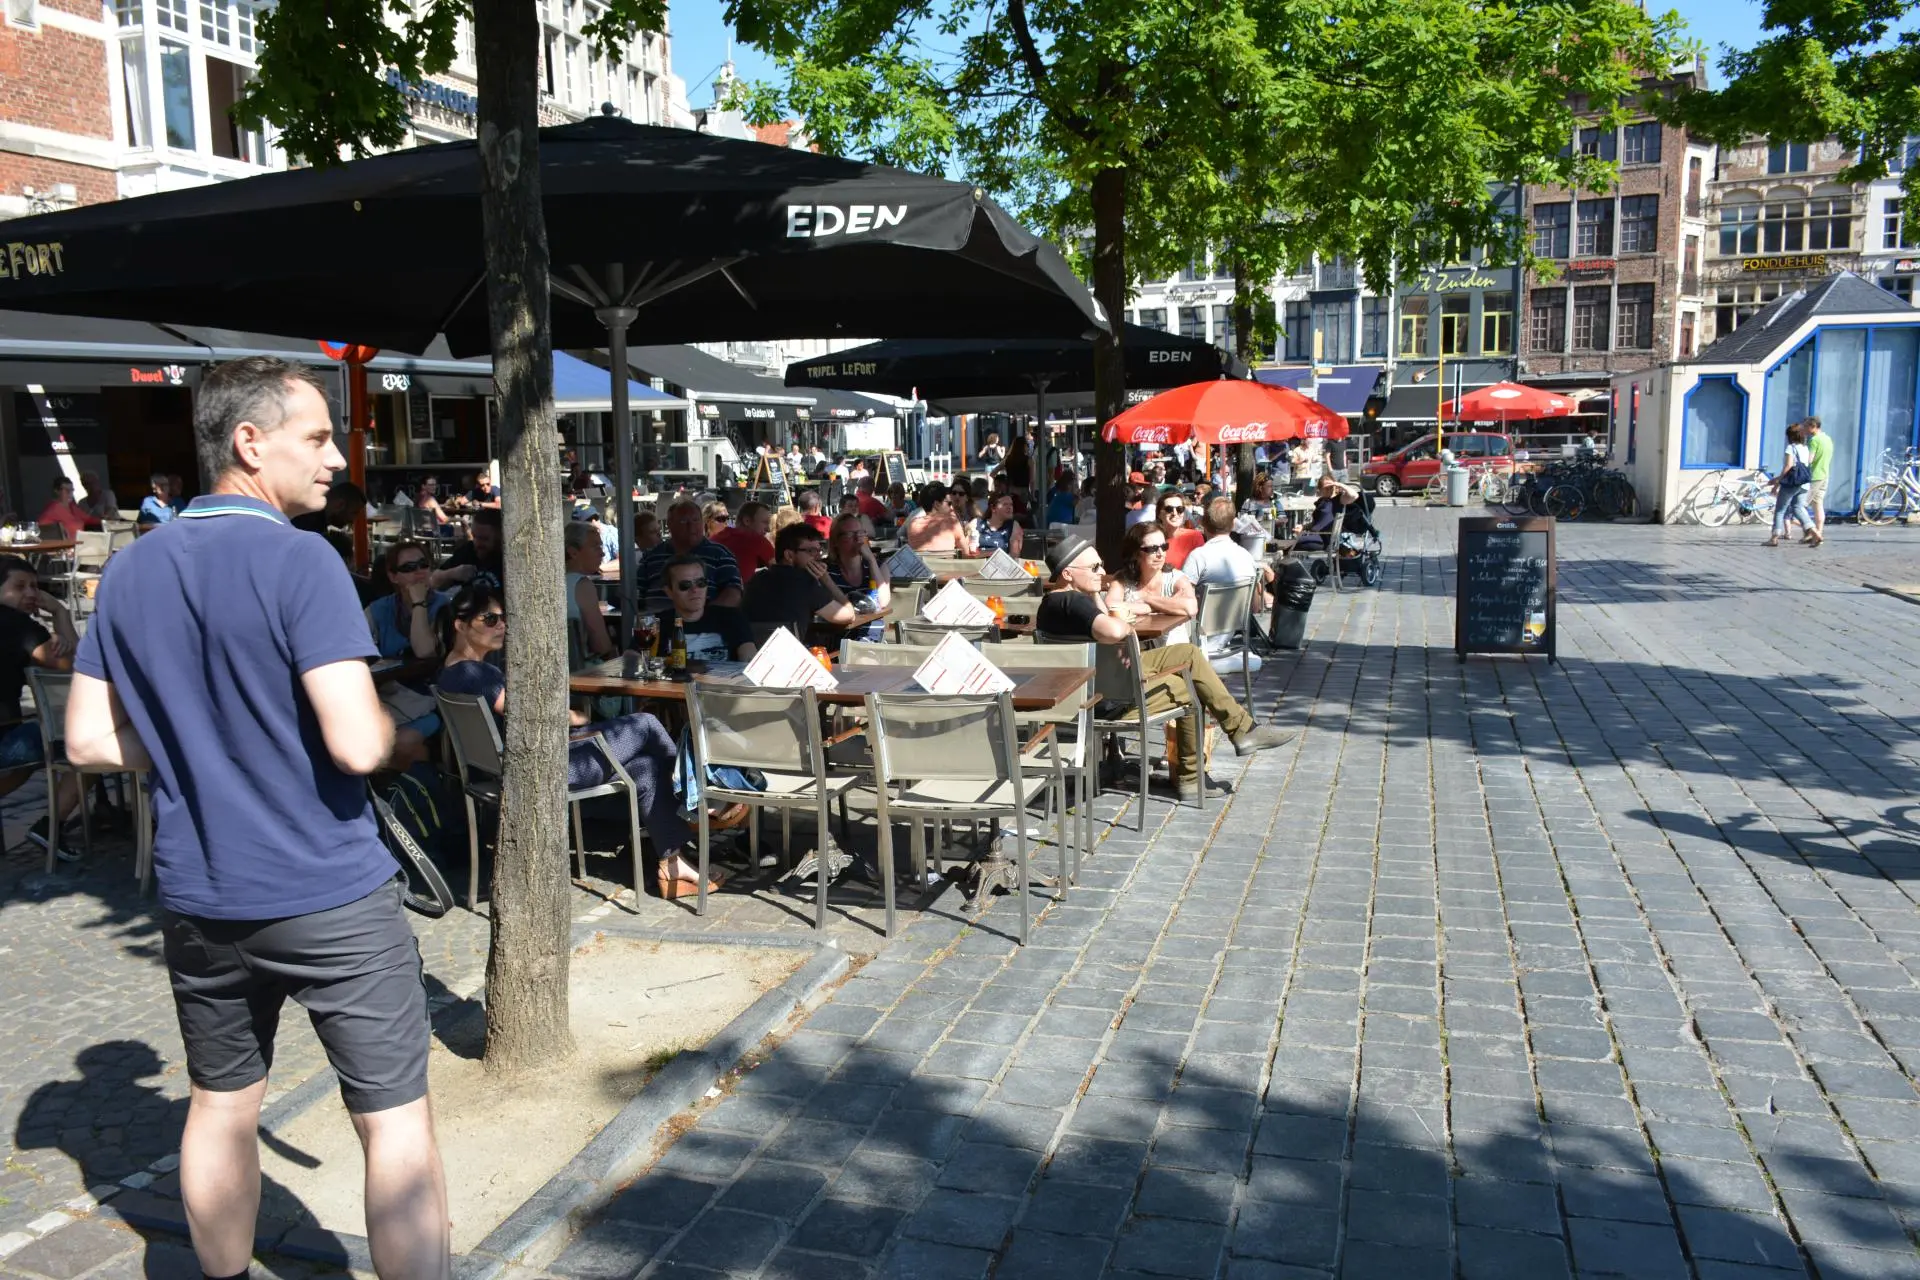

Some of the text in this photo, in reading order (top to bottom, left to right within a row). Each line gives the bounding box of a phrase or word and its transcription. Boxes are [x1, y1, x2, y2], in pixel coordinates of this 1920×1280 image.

[786, 205, 908, 238] EDEN
[1743, 255, 1825, 270] FONDUEHUIS
[1435, 272, 1497, 292] Zuiden
[1149, 350, 1192, 364] EDEN
[130, 367, 164, 383] Duvel
[807, 365, 837, 379] TRIPEL
[382, 373, 411, 391] EDEN
[393, 823, 424, 861] COOLPIX
